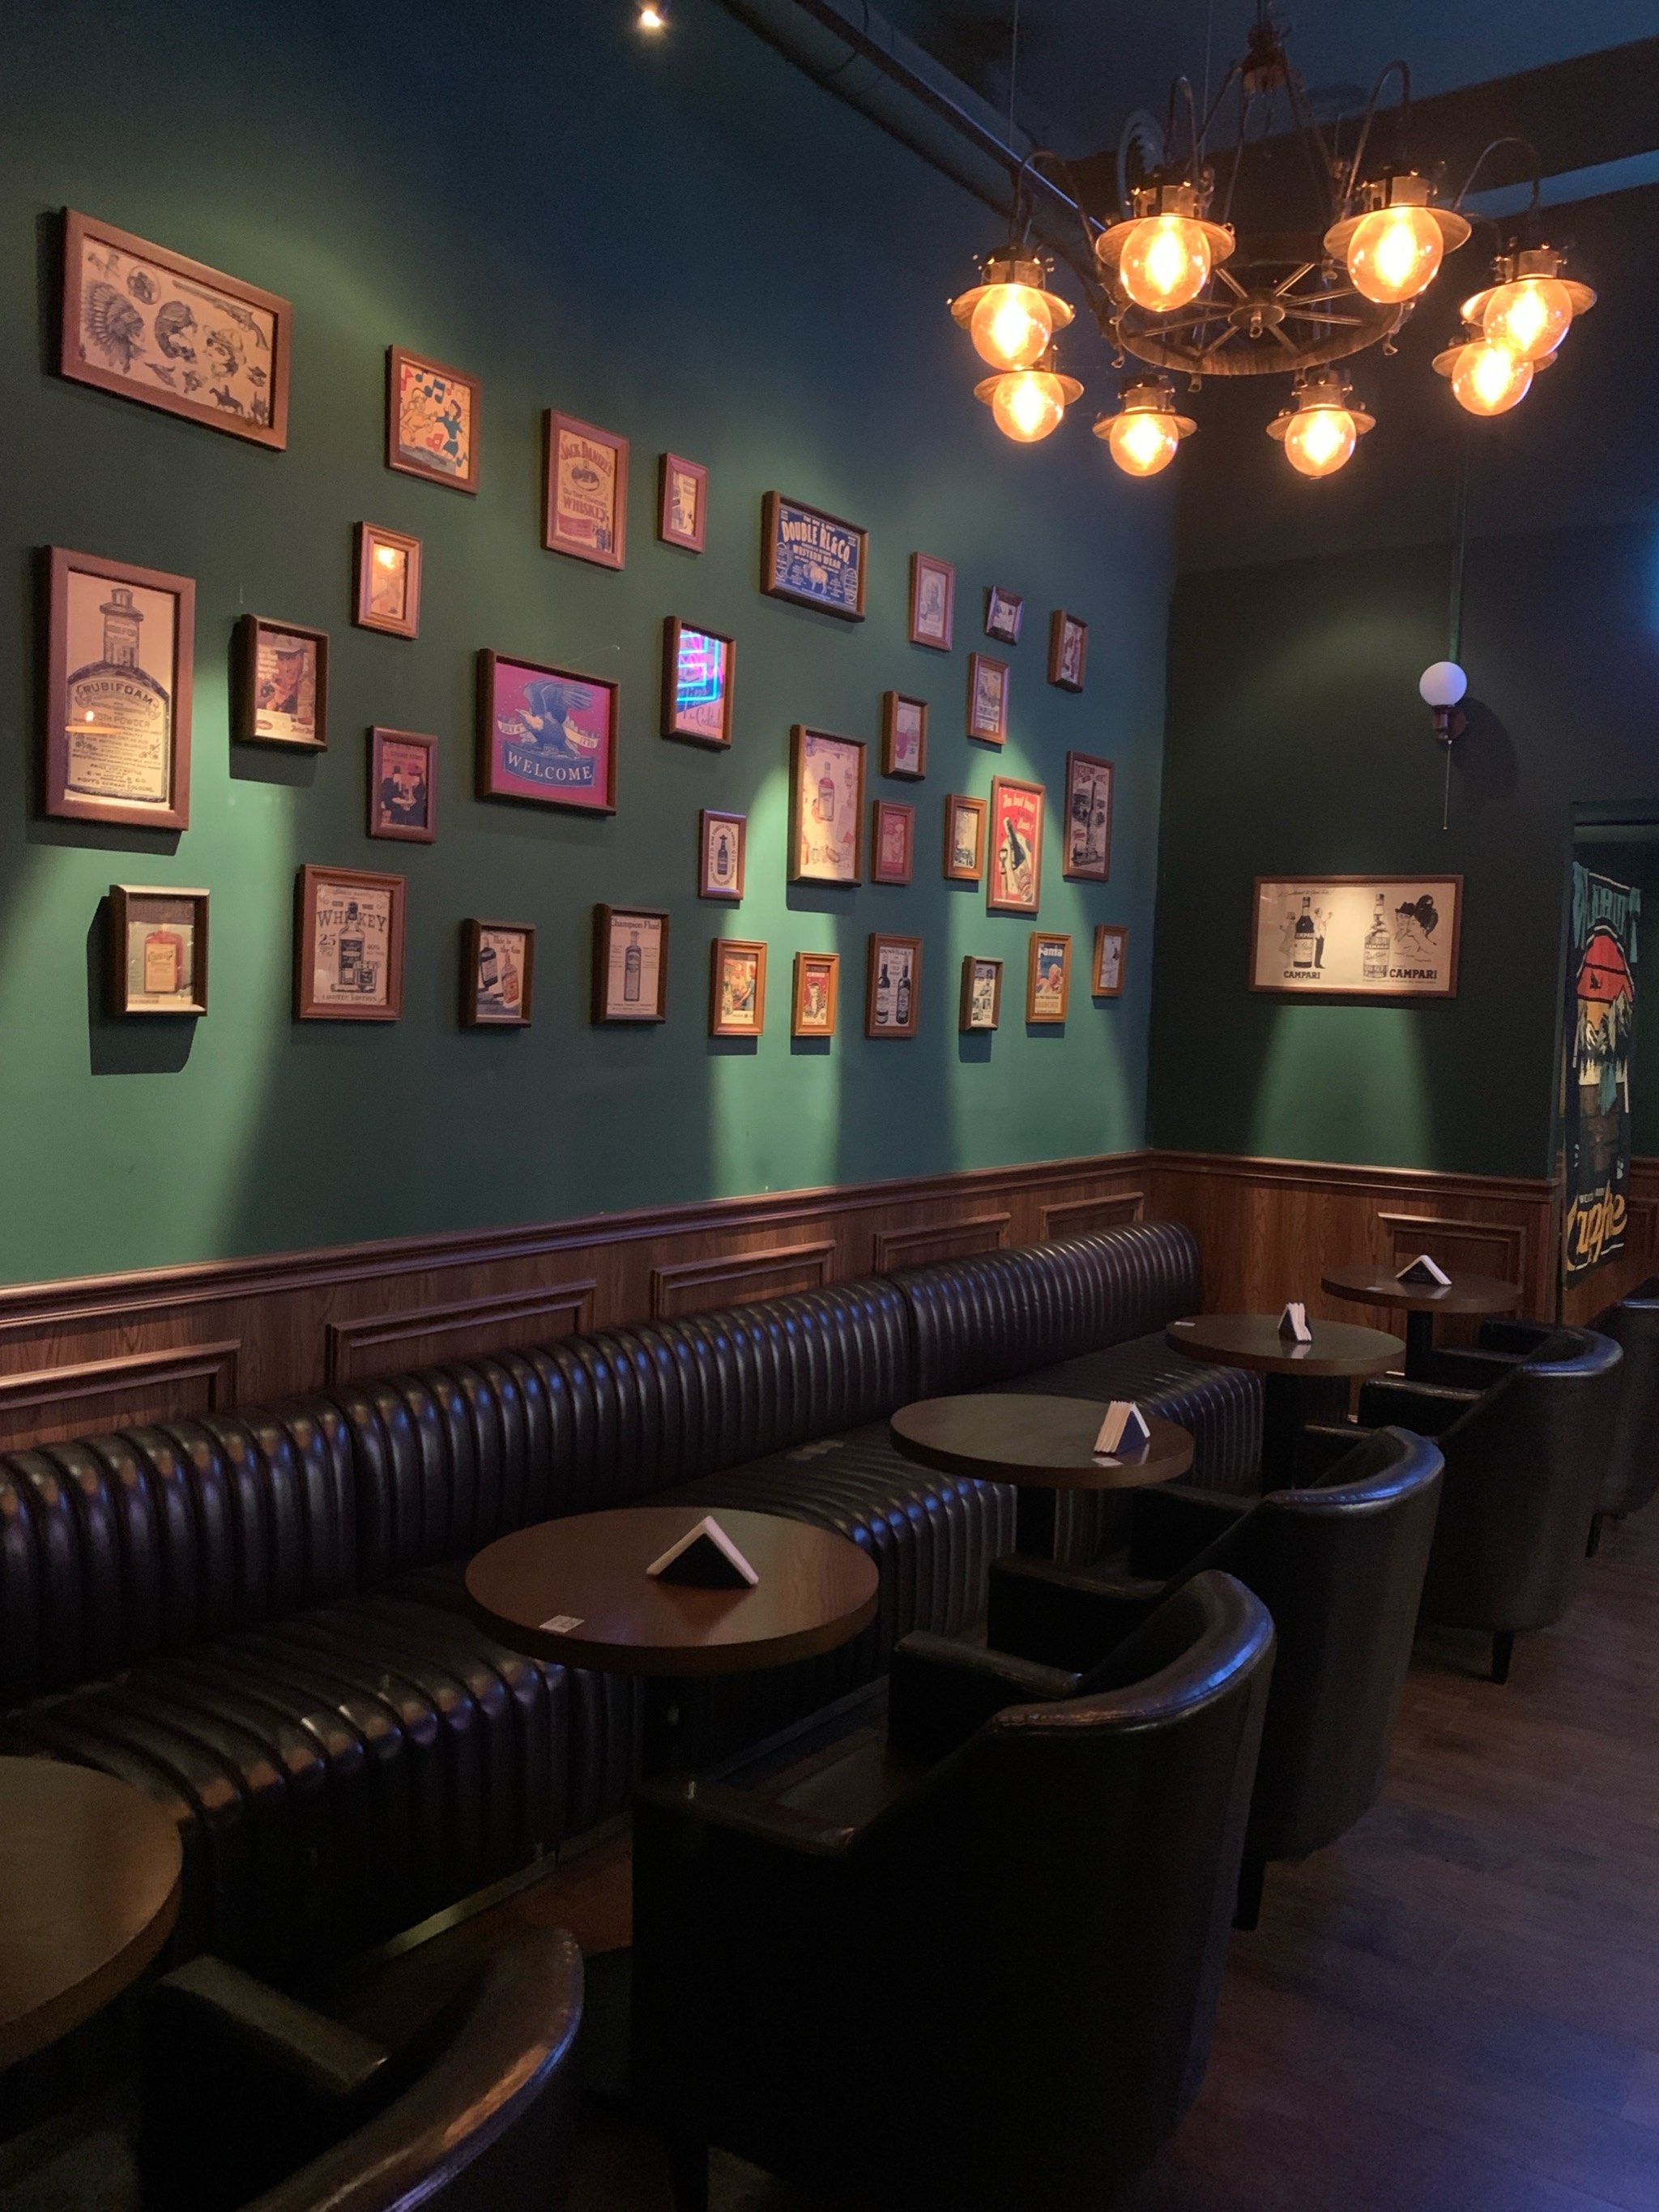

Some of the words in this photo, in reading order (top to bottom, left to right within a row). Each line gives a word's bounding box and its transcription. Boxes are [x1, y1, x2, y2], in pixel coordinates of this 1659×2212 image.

[564, 495, 607, 523] WHISKEY
[781, 521, 817, 545] DOUBLE
[83, 682, 155, 705] RUBIFOAM
[509, 750, 592, 781] WELCOME
[316, 909, 386, 932] WHIKEY
[1283, 971, 1320, 980] CAMPARI
[1389, 968, 1438, 980] CAMPARI
